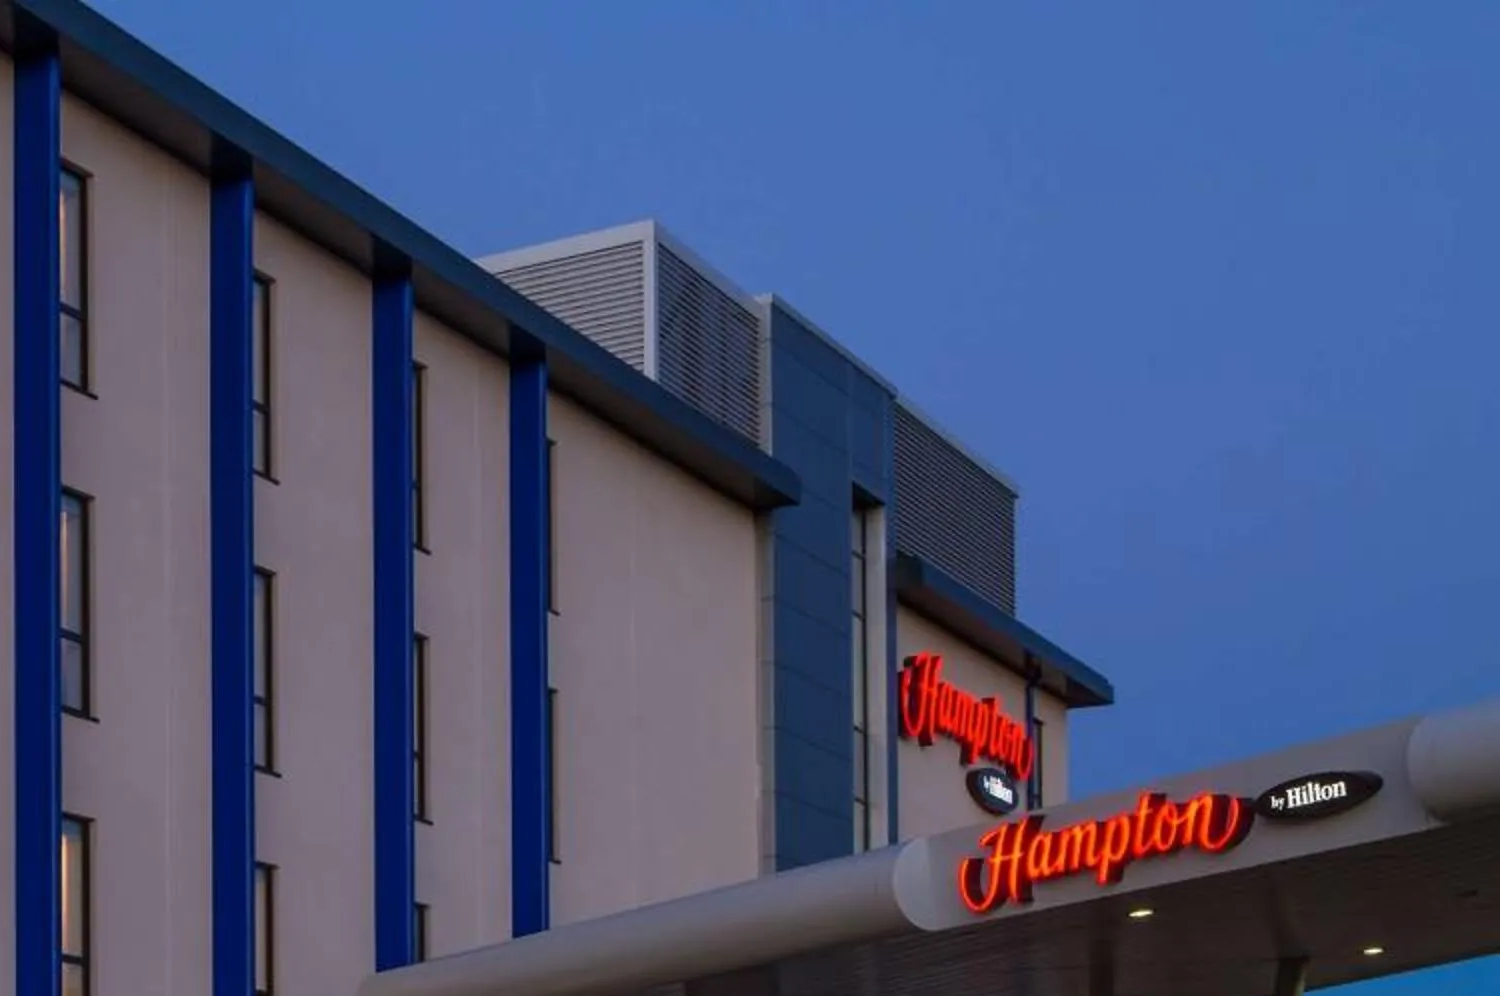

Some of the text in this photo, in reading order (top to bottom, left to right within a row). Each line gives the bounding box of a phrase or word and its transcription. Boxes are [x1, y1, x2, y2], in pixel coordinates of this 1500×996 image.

[901, 651, 1035, 781] Hampton
[958, 790, 1243, 915] Hampton
[1270, 780, 1348, 811] by Hilton
